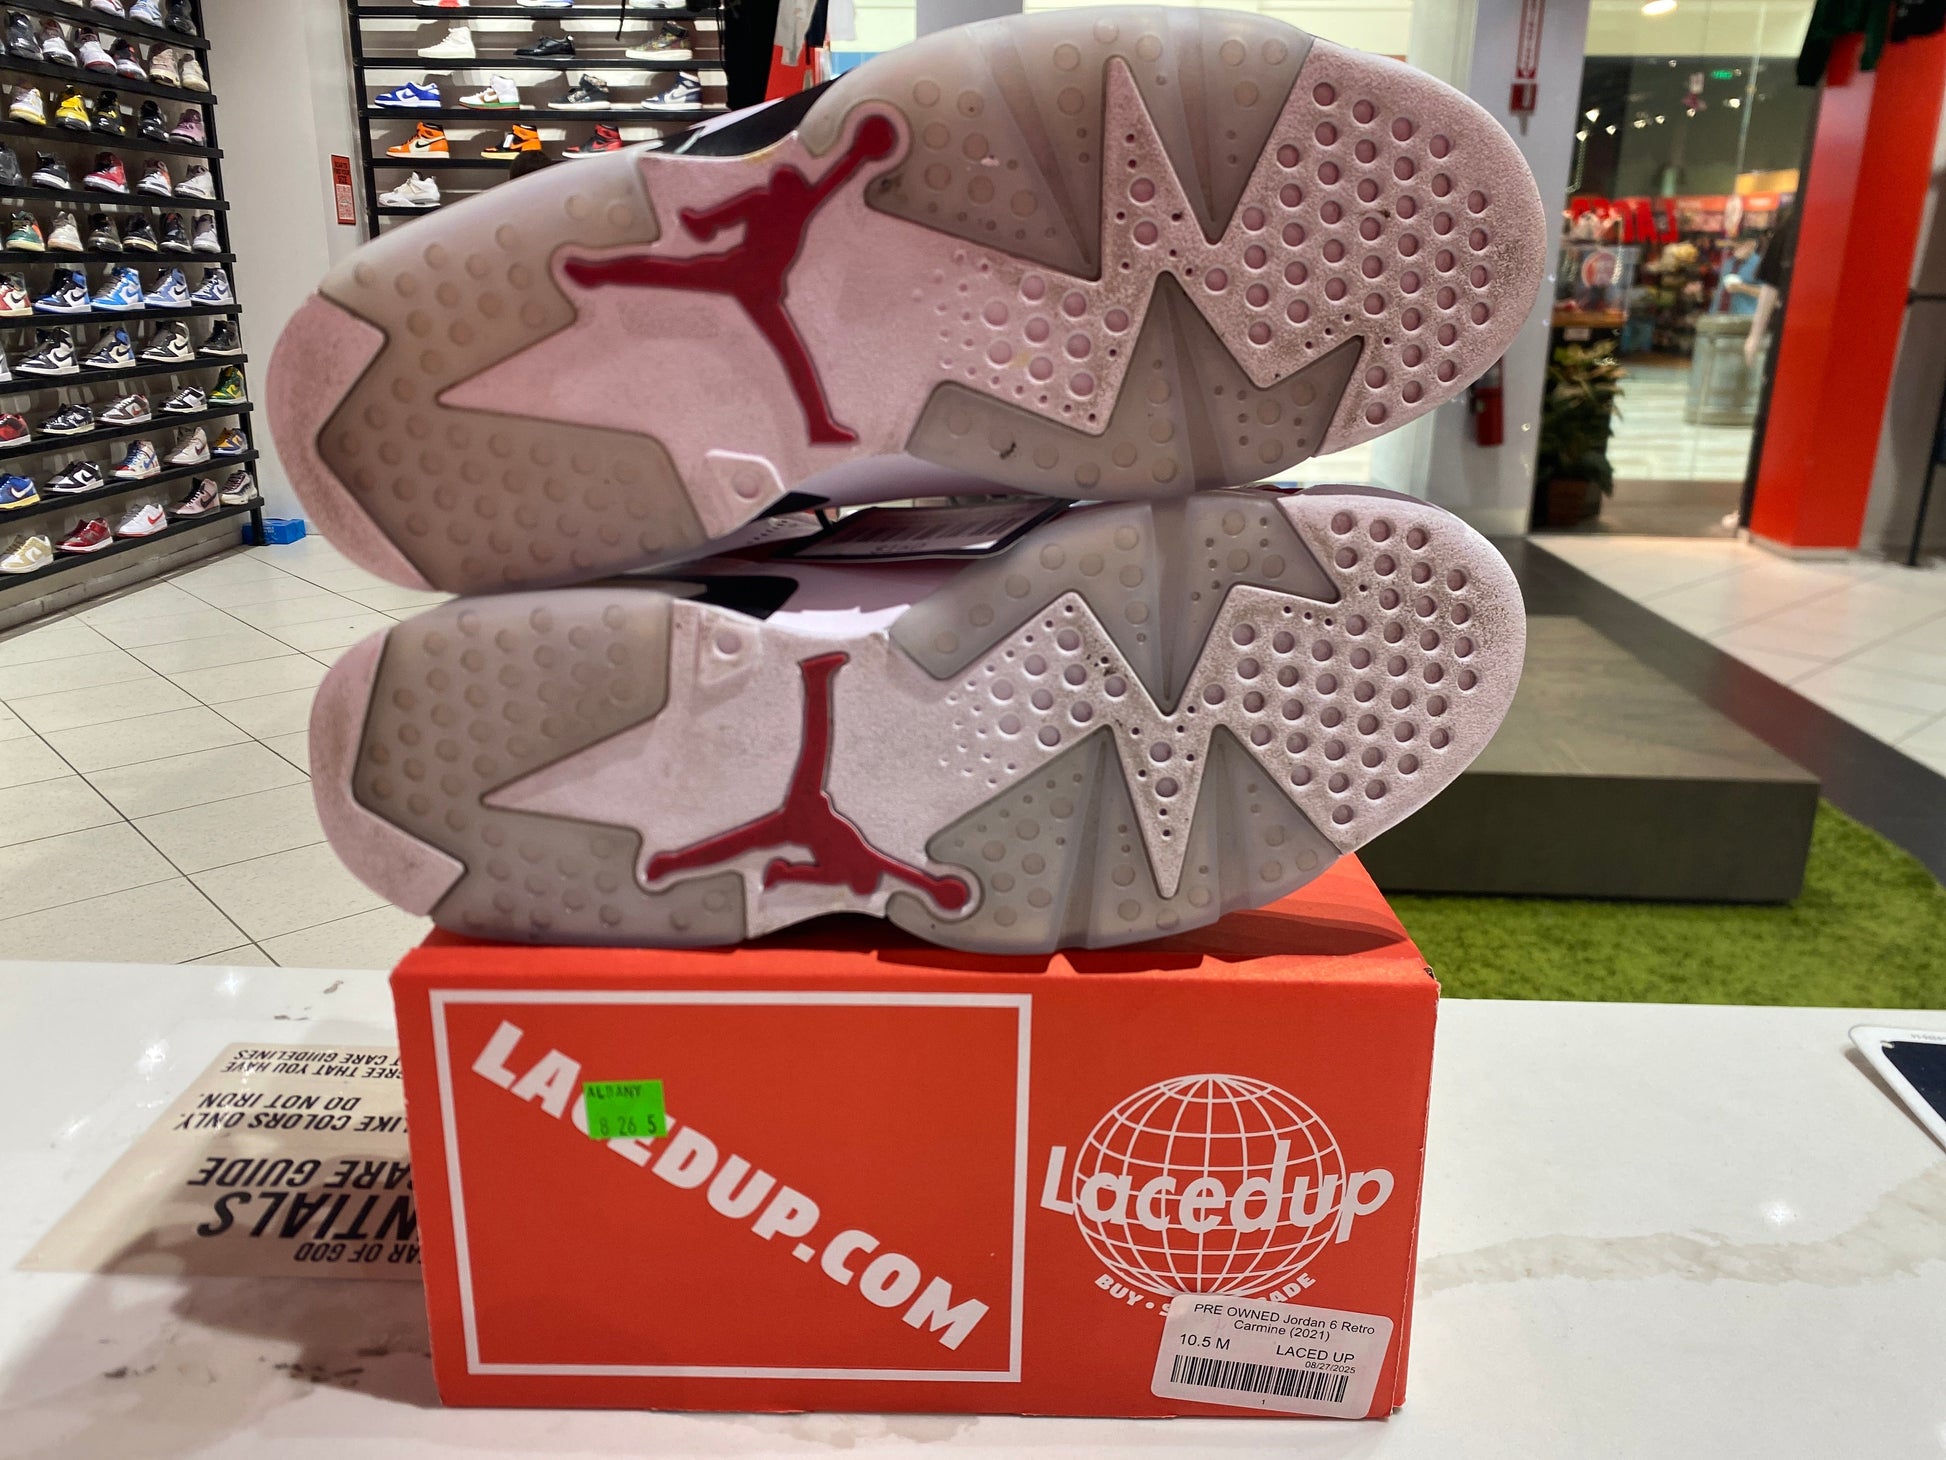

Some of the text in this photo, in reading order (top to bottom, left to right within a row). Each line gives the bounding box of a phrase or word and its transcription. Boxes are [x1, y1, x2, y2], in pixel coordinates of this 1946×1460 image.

[233, 1050, 338, 1063] GUIDELINES
[340, 1053, 388, 1066] CARE
[221, 1061, 271, 1074] HAVE
[273, 1062, 308, 1074] YOU
[312, 1065, 359, 1078] THAT
[197, 1092, 362, 1112] DO NOT IRON.
[173, 1111, 408, 1133] IKE COLORS ONLY.
[187, 1157, 413, 1190] ARE GUIDE
[1040, 1139, 1395, 1245] Lacedup
[197, 1191, 419, 1241] NTIALS
[294, 1242, 421, 1264] AR OF GOD
[1094, 1273, 1145, 1306] BUY
[1257, 1272, 1317, 1302] ADE
[1194, 1303, 1375, 1335] PRE OWNED Jordan 6 Retro
[1234, 1319, 1331, 1342] Carmine (2021)
[1179, 1333, 1230, 1350] 10.5 M
[1276, 1345, 1355, 1364] LACED UP
[1305, 1361, 1356, 1374] 08/27/2025
